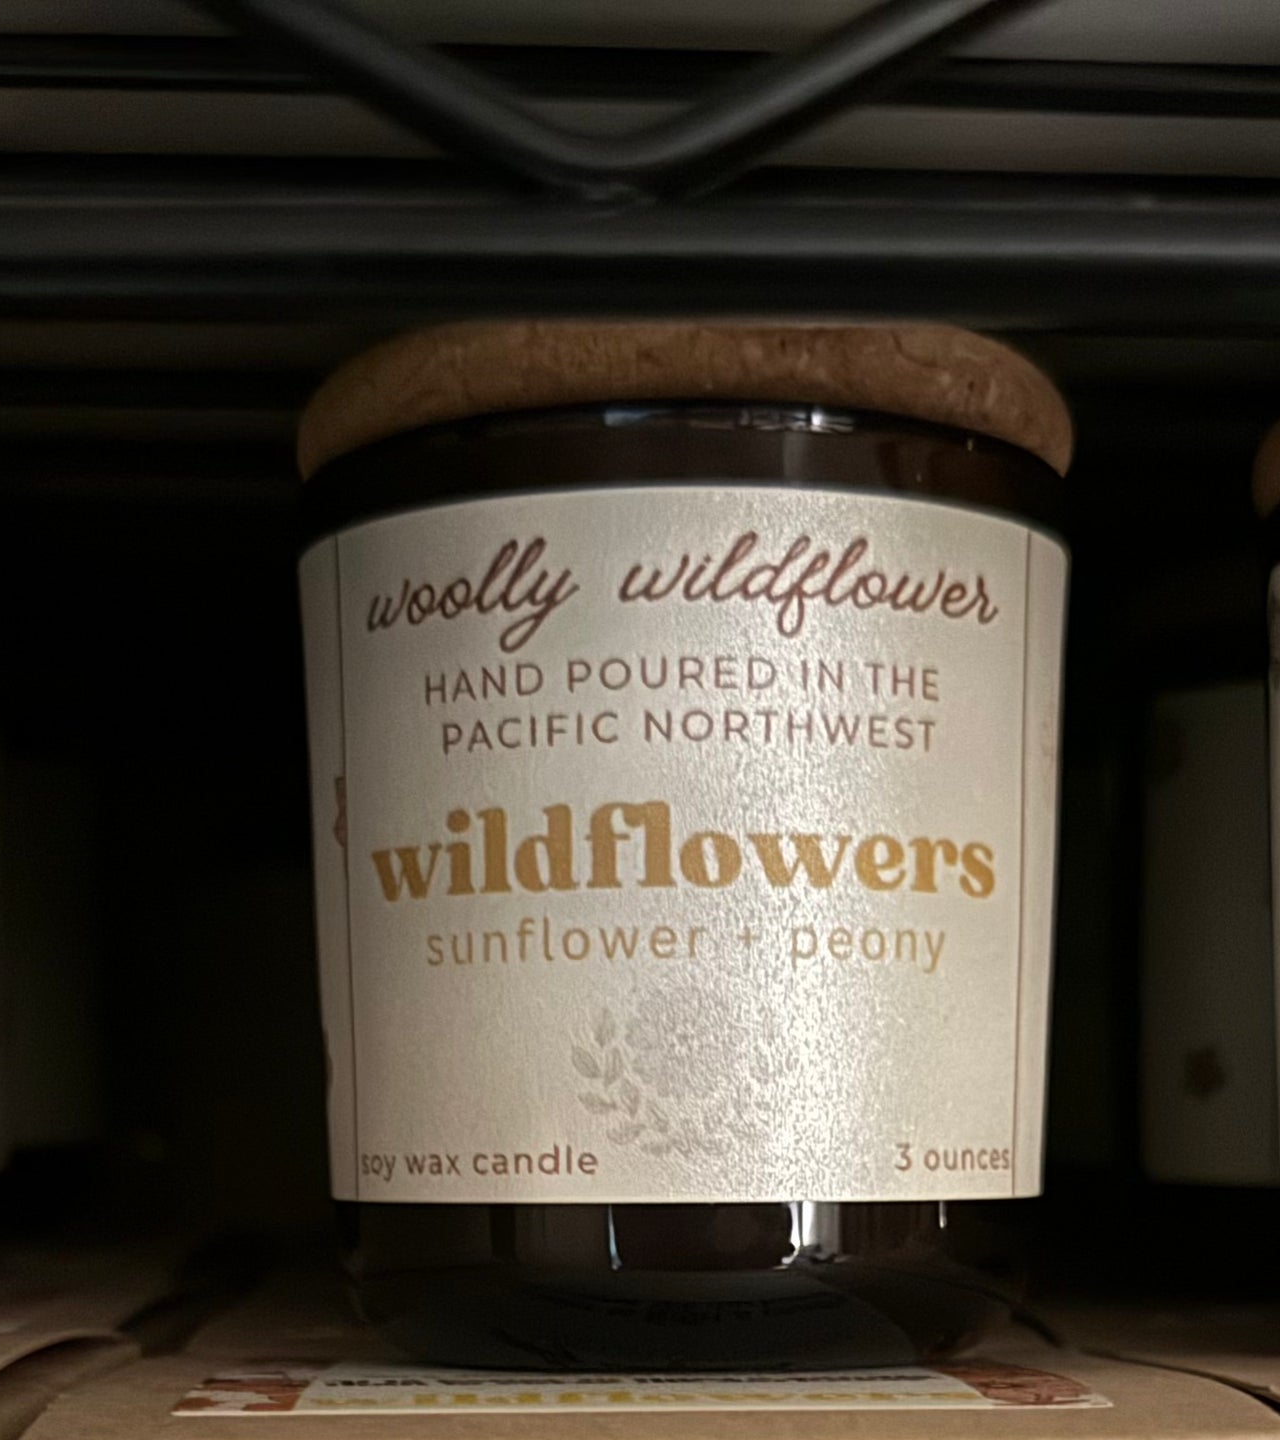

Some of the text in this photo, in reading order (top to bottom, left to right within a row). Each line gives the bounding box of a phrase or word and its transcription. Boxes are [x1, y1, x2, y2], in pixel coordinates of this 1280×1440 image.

[367, 530, 999, 653] woolly wildflower
[423, 655, 941, 706] HAND POURED IN THE
[441, 706, 937, 756] PACIFIC NORTHWEST
[370, 800, 998, 903] wildflowers
[425, 917, 948, 974] sunflower + peony
[360, 1145, 600, 1182] soy wax candle
[893, 1141, 1013, 1174] 3 ounces
